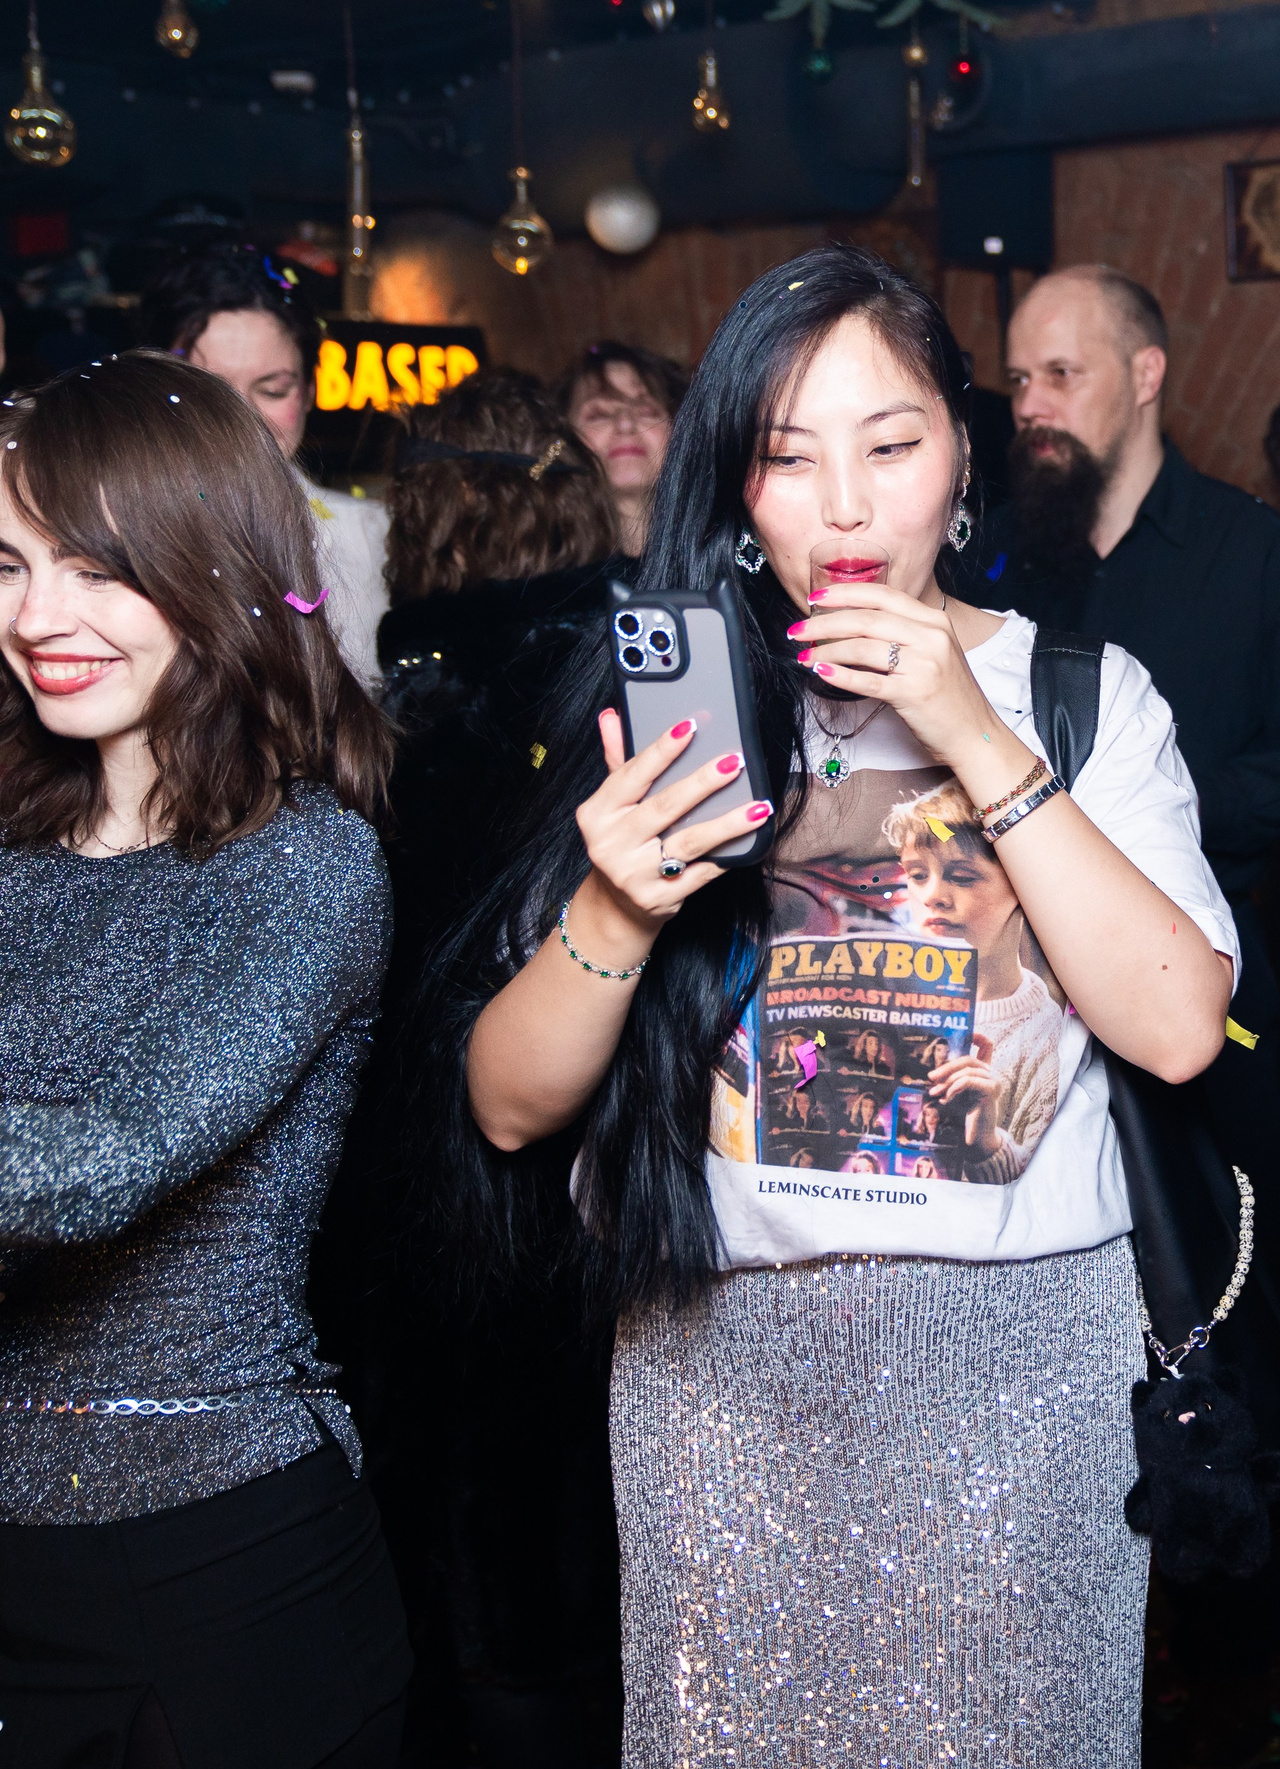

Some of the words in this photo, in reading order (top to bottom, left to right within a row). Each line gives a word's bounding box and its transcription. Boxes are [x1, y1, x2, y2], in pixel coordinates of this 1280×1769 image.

[767, 941, 972, 984] PLAYBOY
[766, 1007, 784, 1023] TV
[787, 1005, 887, 1024] NEWSCASTER
[889, 1011, 942, 1028] BARES
[943, 1015, 969, 1030] ALL
[758, 1180, 861, 1201] LEMINSCATE
[865, 1189, 928, 1206] STUDIO
